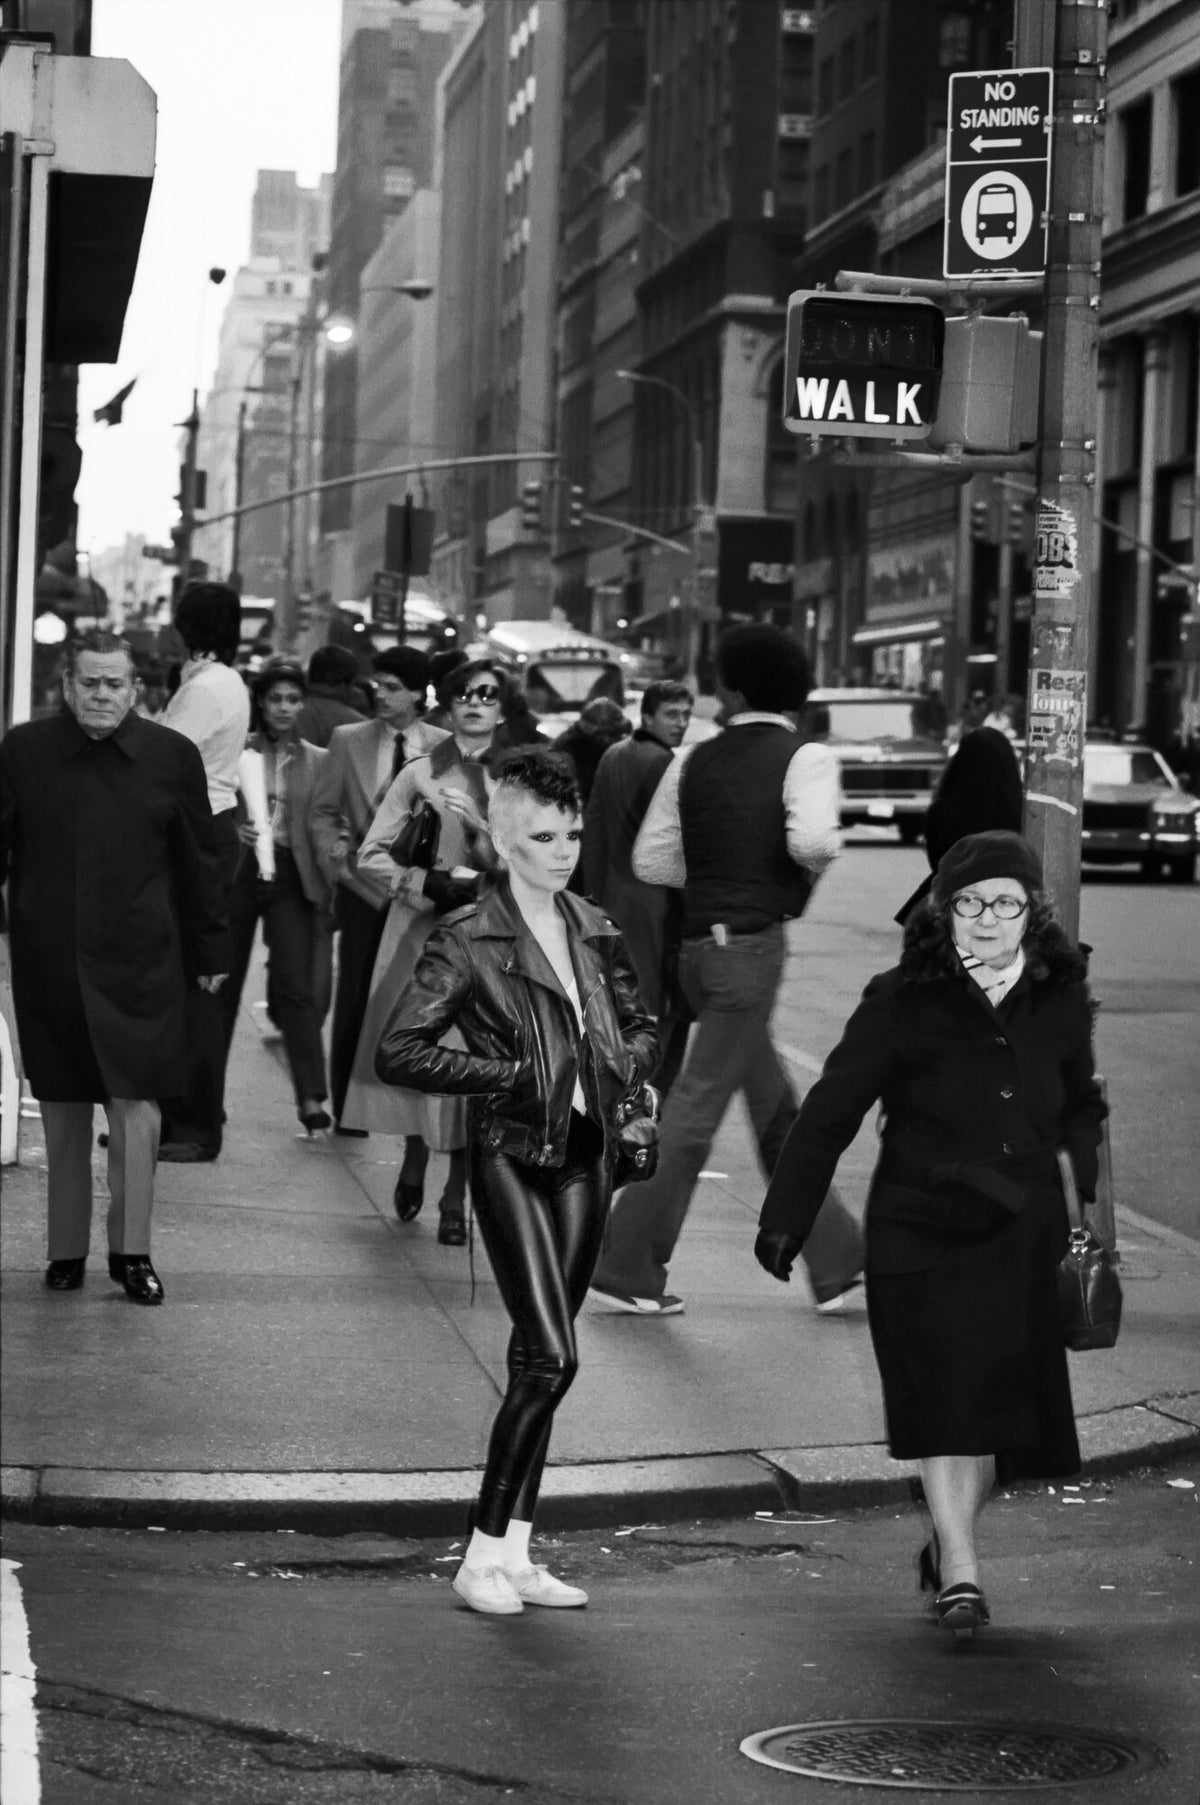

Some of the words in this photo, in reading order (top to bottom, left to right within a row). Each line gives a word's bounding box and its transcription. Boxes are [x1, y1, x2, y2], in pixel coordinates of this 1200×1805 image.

[984, 81, 1016, 102] NO
[960, 106, 1040, 129] STANDING
[796, 376, 923, 425] WALK
